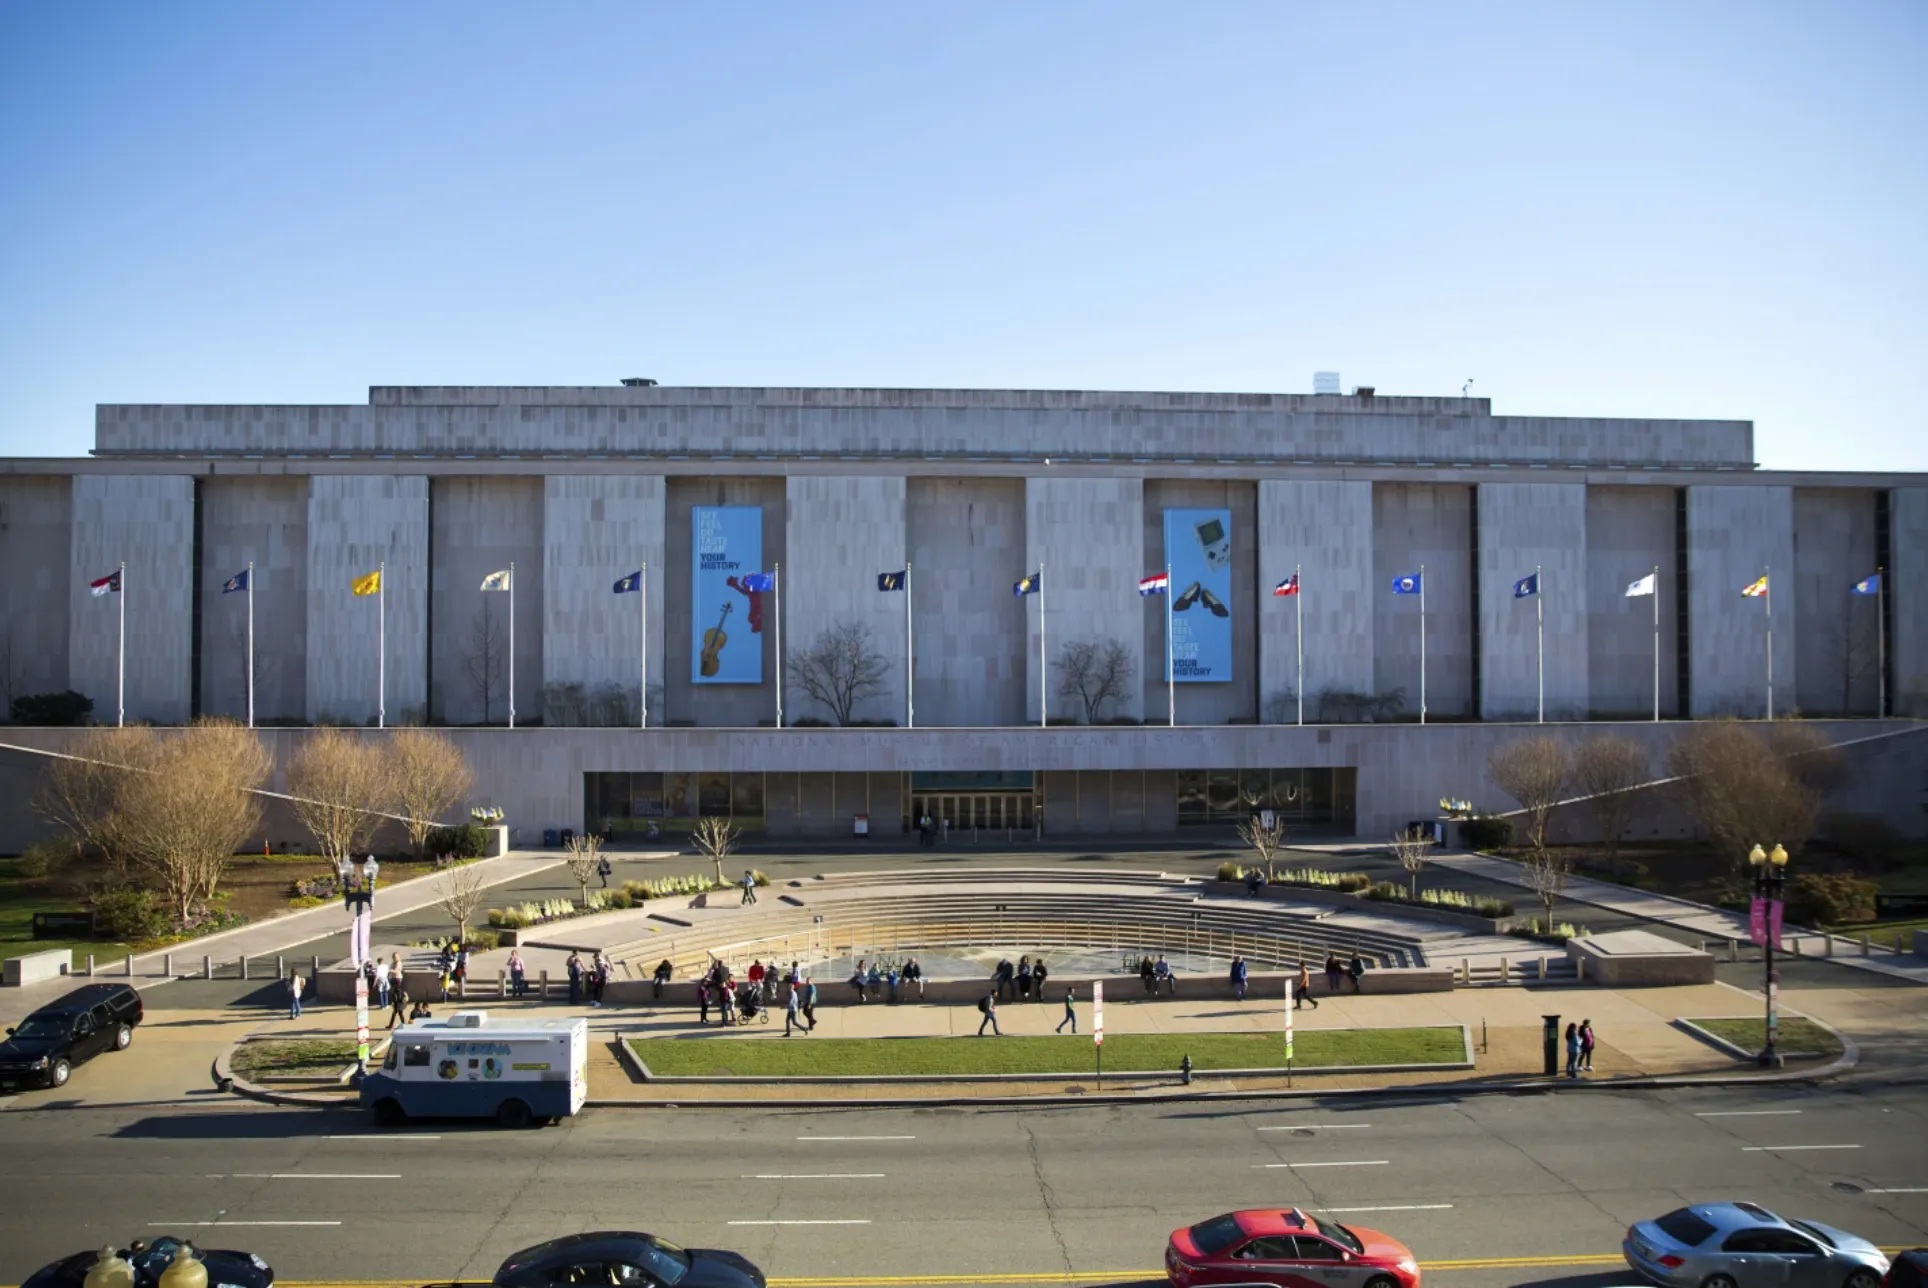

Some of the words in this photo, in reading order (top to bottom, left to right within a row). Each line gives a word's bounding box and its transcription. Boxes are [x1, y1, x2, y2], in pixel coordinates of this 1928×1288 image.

[700, 553, 726, 562] YOUR
[700, 561, 741, 571] HISTORY
[1173, 659, 1198, 667] YOUR
[1173, 667, 1212, 677] HISTORY
